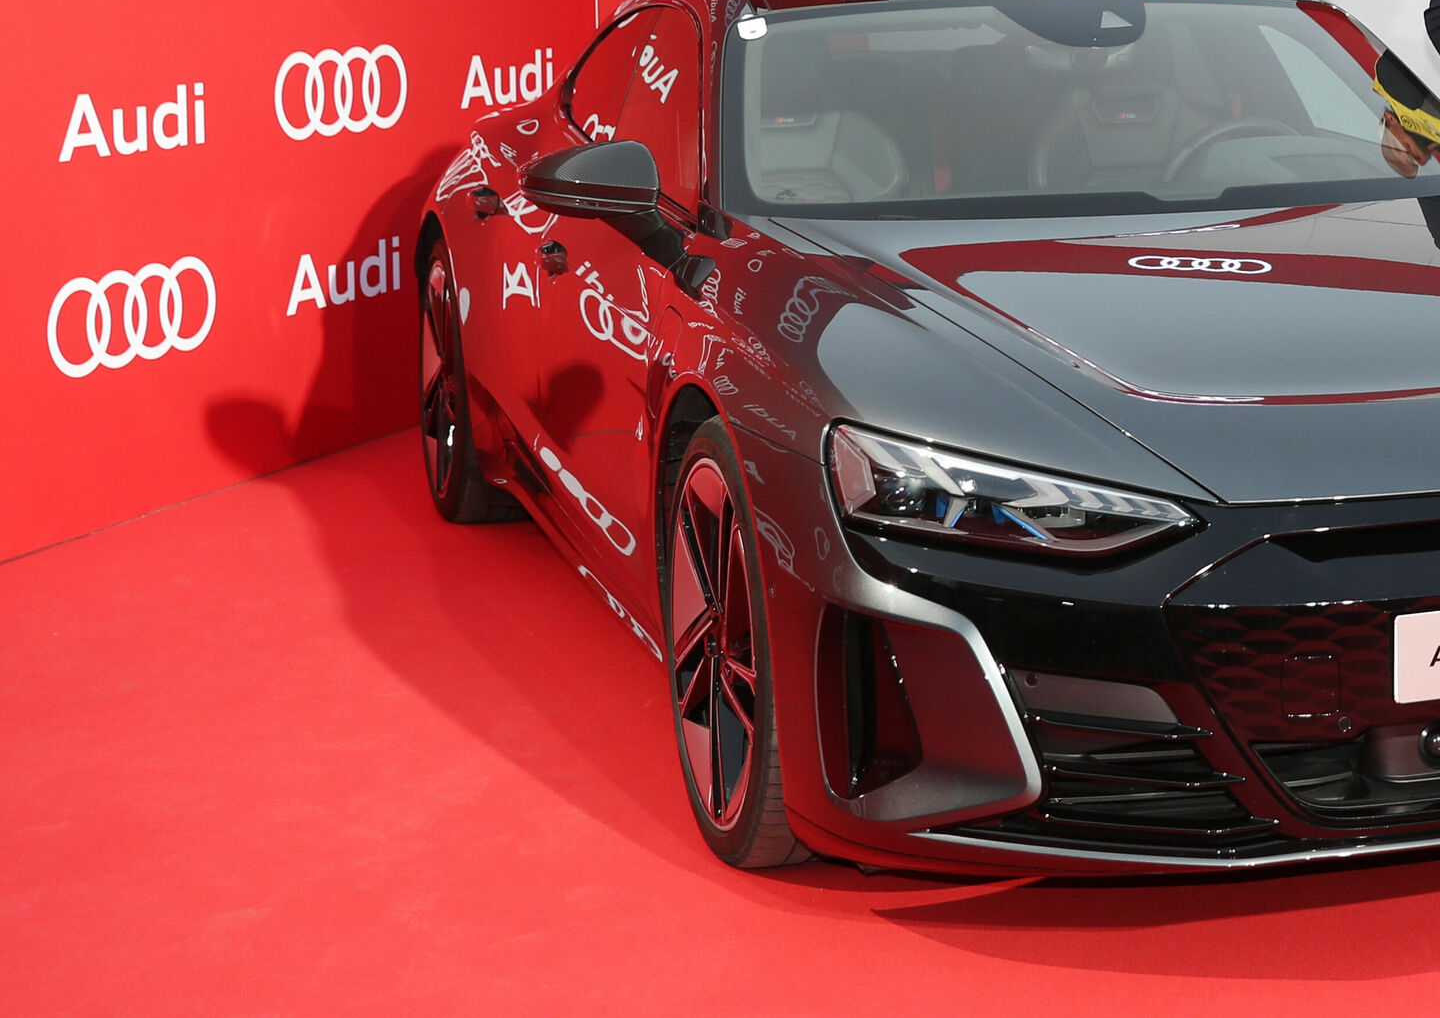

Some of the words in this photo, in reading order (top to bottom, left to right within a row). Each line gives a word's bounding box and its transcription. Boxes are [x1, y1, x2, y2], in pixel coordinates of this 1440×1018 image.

[461, 48, 554, 109] Audi
[59, 82, 206, 162] Audi
[286, 236, 400, 316] Audi
